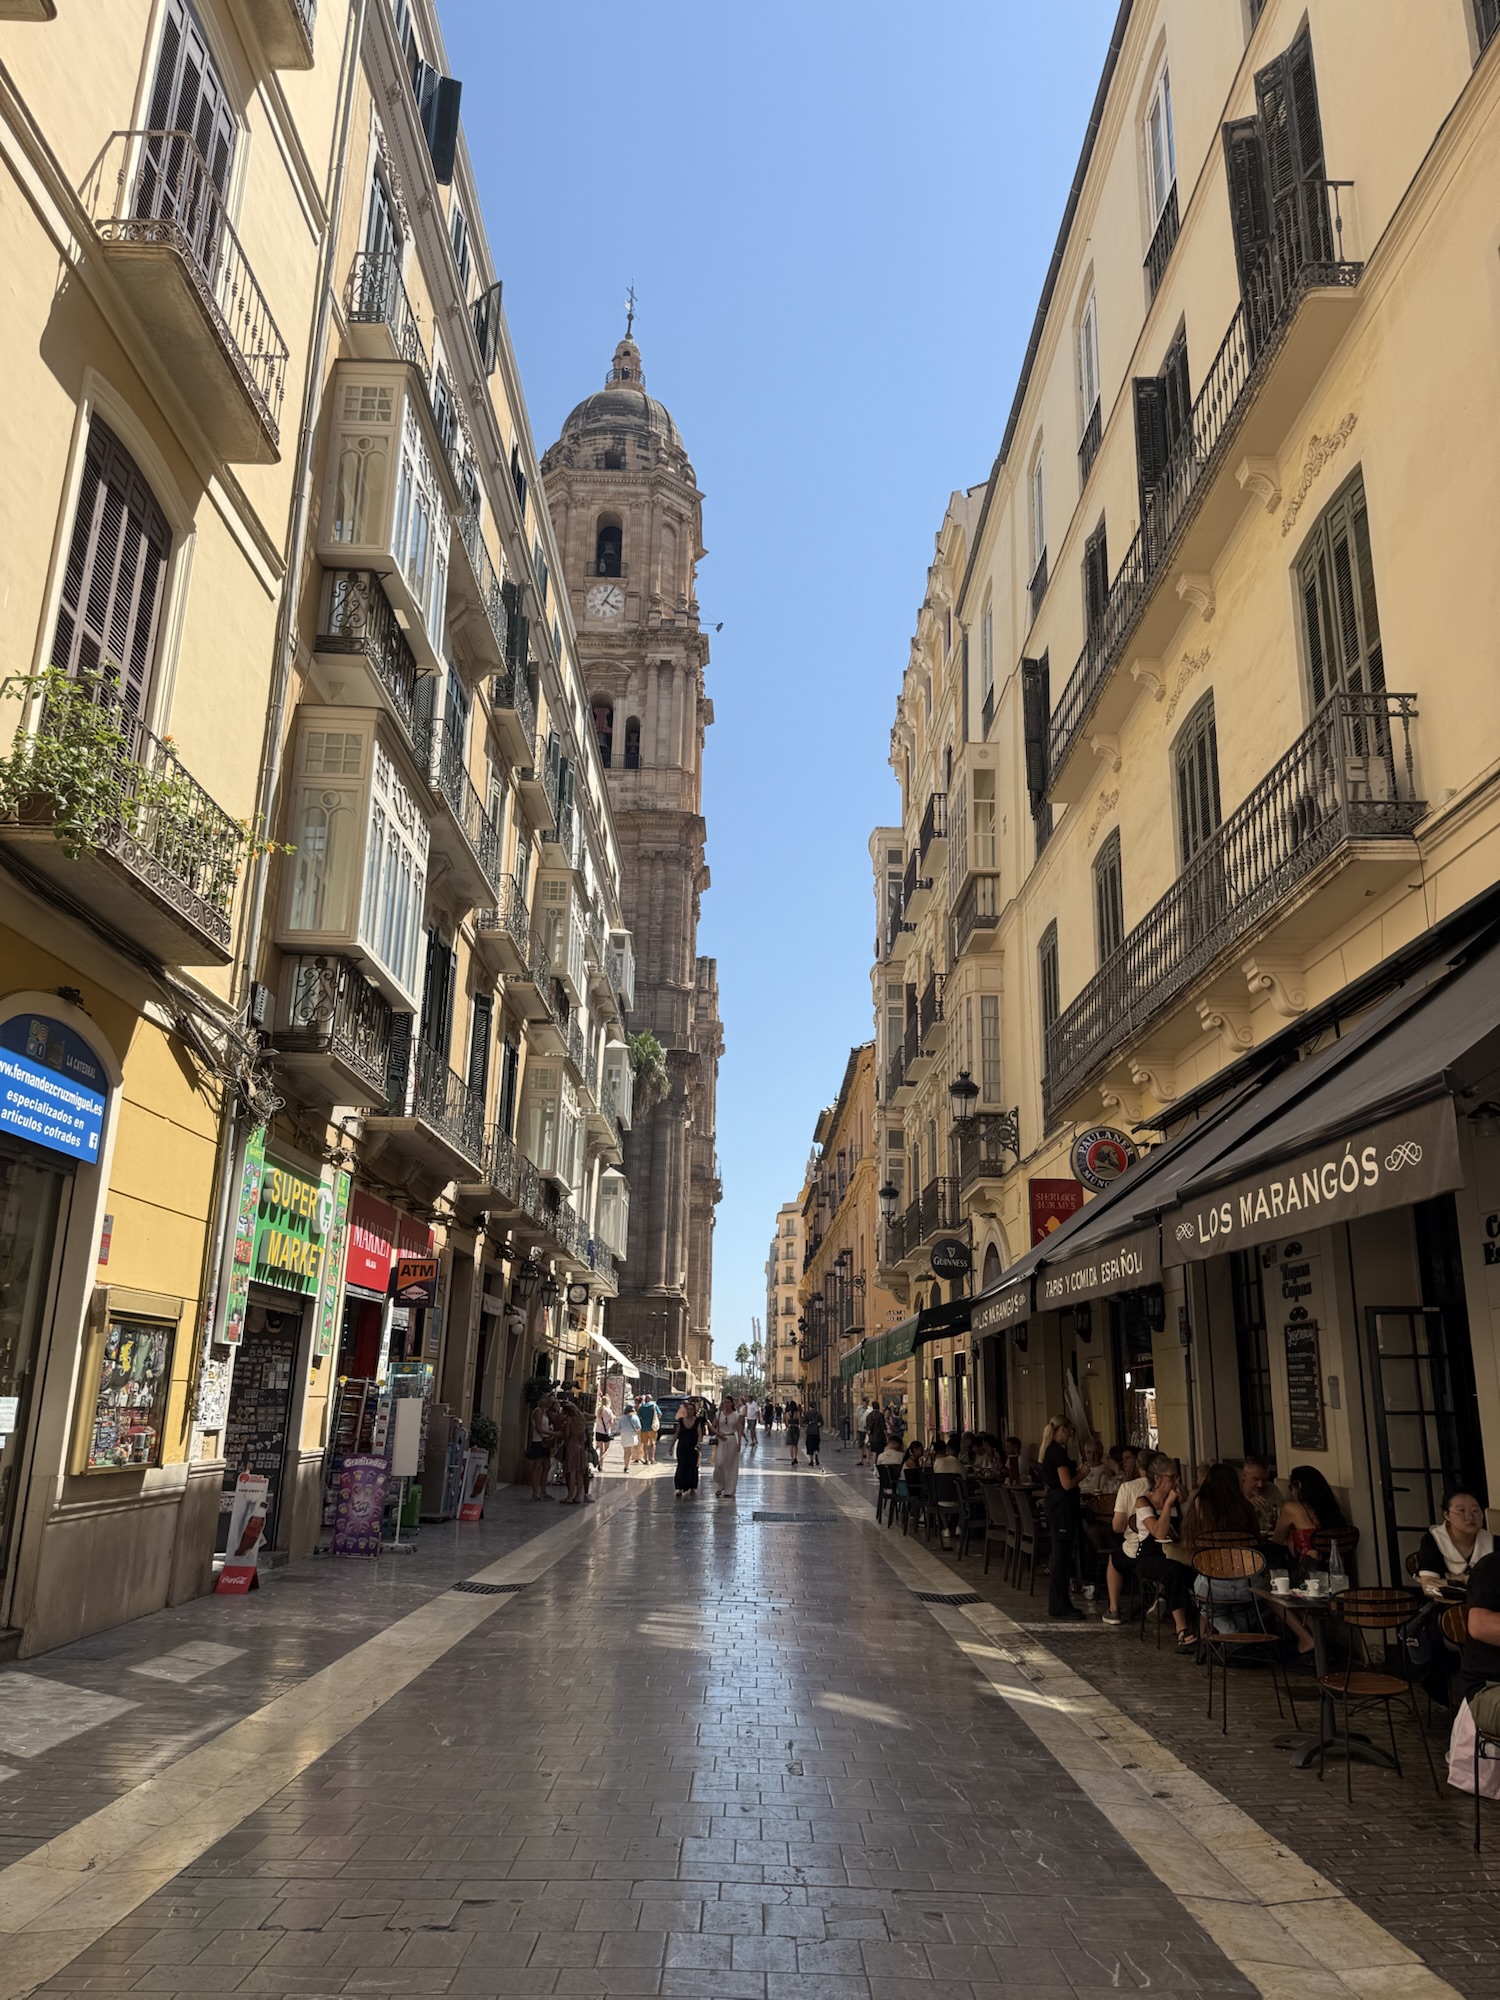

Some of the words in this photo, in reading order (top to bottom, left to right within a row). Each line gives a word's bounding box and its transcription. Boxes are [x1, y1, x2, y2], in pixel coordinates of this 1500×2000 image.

[6, 1089, 73, 1125] especializados
[73, 1118, 85, 1130] en
[0, 1108, 43, 1132] artículos
[43, 1125, 82, 1147] cofrades
[1077, 1131, 1134, 1156] PAULANER
[271, 1167, 317, 1220] SUPER
[1035, 1192, 1077, 1202] SHERLOCK
[1197, 1202, 1233, 1244] LOS
[1238, 1142, 1379, 1229] MARANGÓS
[1037, 1201, 1077, 1210] HOLMES
[267, 1229, 325, 1279] MARKET
[933, 1255, 968, 1268] GUINNESS
[400, 1264, 434, 1277] ATM
[1070, 1266, 1099, 1292] COMIDA
[1280, 1263, 1310, 1284] Tapas
[1282, 1282, 1312, 1302] Copas
[221, 1575, 248, 1585] Coca-Cola
